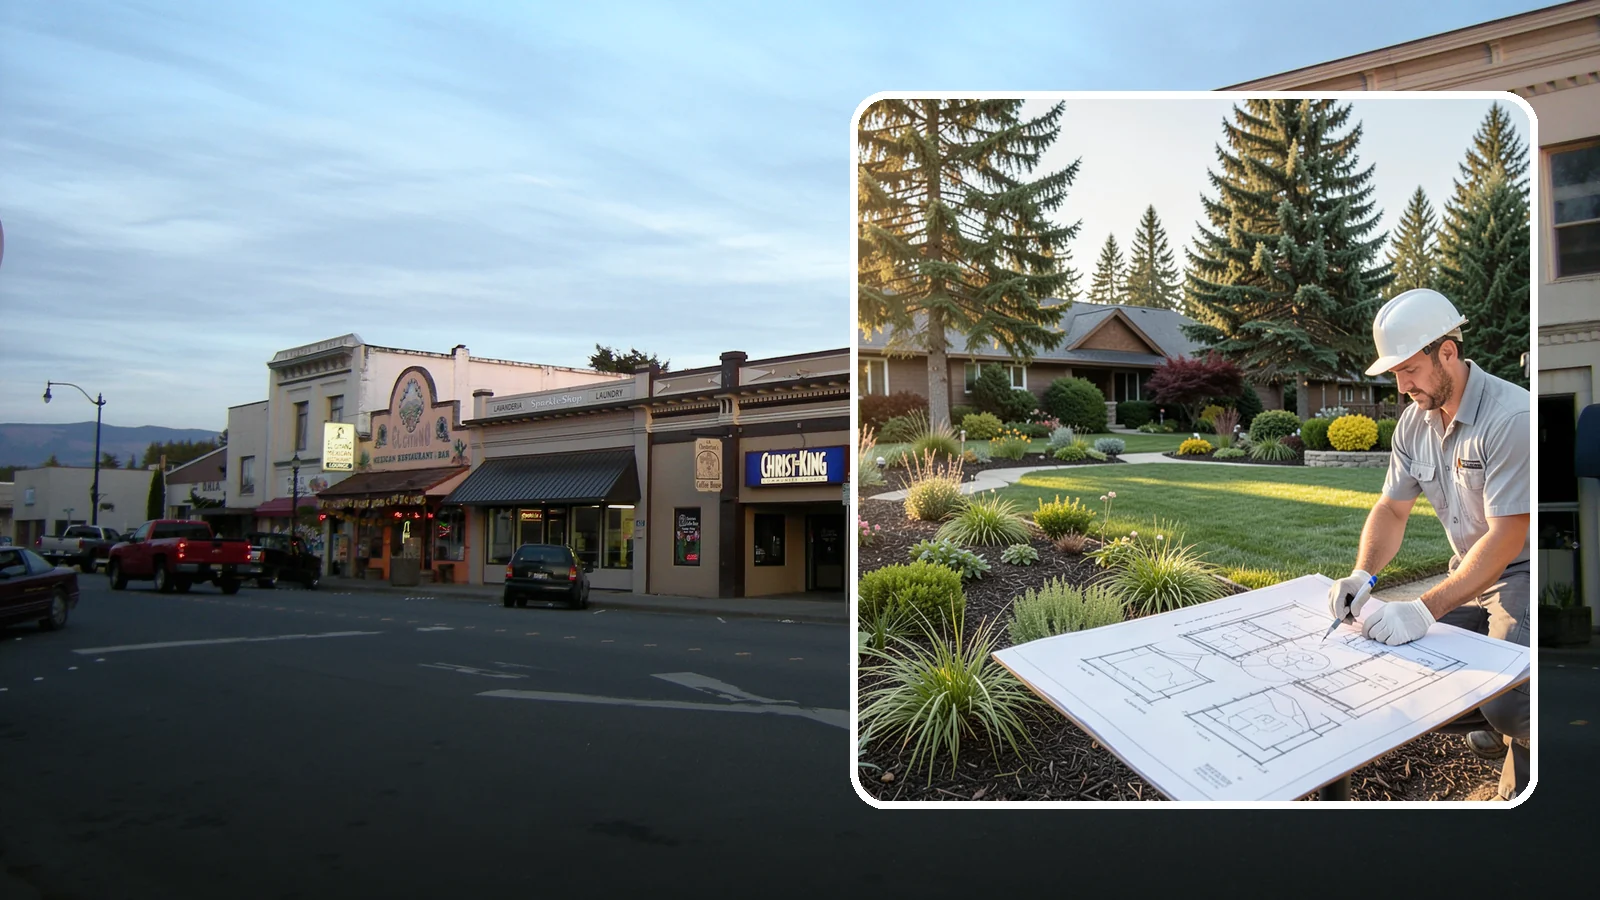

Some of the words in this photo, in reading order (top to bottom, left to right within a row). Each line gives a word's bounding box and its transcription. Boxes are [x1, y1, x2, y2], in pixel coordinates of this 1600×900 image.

[595, 389, 623, 400] LAUNDRY
[493, 402, 523, 412] LAVANDERIA
[531, 396, 561, 409] Sparkle
[562, 394, 582, 405] Shop
[397, 452, 434, 462] RESTAURANT
[438, 450, 450, 459] BAR
[799, 449, 828, 477] KING
[697, 480, 709, 489] Coffee
